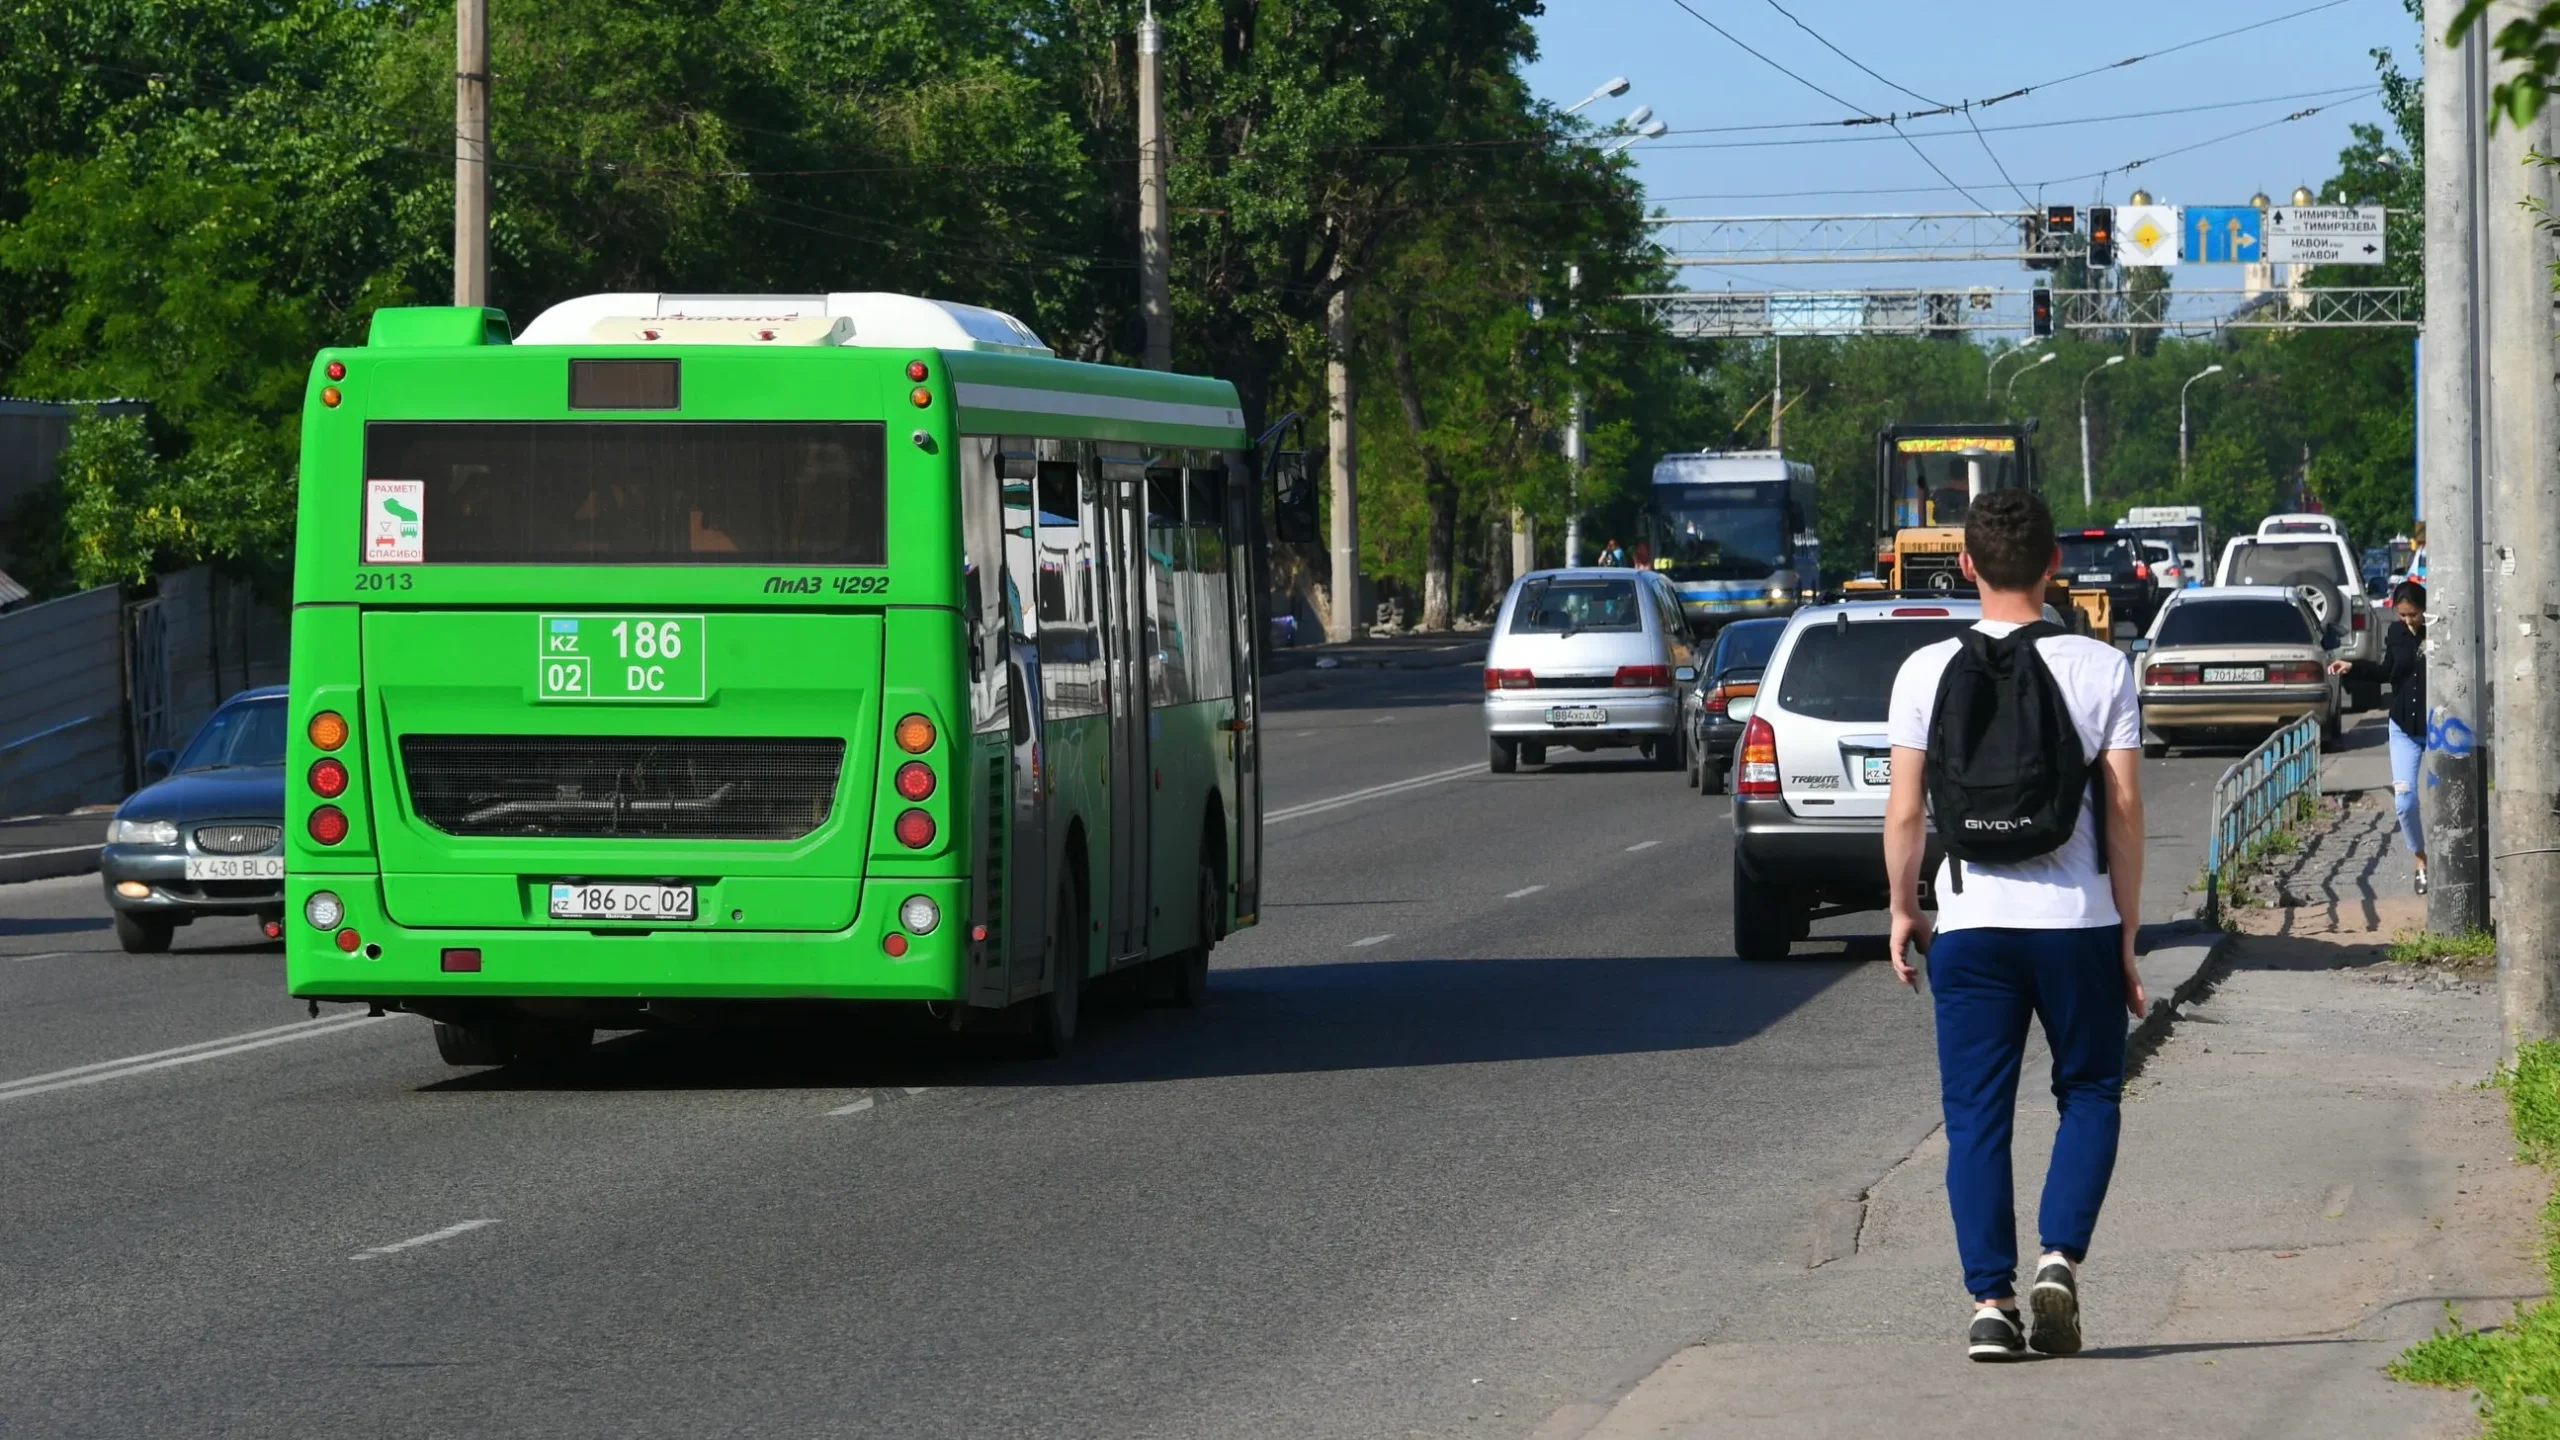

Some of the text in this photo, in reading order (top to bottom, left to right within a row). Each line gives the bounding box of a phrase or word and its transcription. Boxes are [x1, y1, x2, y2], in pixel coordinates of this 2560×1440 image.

[2293, 210, 2360, 220] ТИМИРЯЗЕВ
[2304, 222, 2377, 232] ТИМИРЯЗЕВА
[2291, 239, 2328, 248] НАВОИ
[2301, 250, 2339, 260] НАВОИ
[374, 484, 417, 494] РАХМЕТ!
[369, 549, 421, 559] СПАСИБО!
[355, 573, 413, 591] 2013
[832, 576, 890, 594] 4292
[550, 635, 579, 652] KZ
[612, 621, 682, 659] 186
[548, 664, 582, 692] 02
[627, 665, 665, 692] DC
[1555, 711, 1573, 721] 884
[1592, 711, 1605, 720] 05
[1867, 770, 1880, 778] KZ
[1791, 775, 1840, 784] TRIBUTE
[1965, 816, 2032, 830] GIVOVA
[193, 860, 278, 877] X 430 BLO
[553, 901, 569, 910] KZ
[577, 889, 689, 912] 186 DC 02
